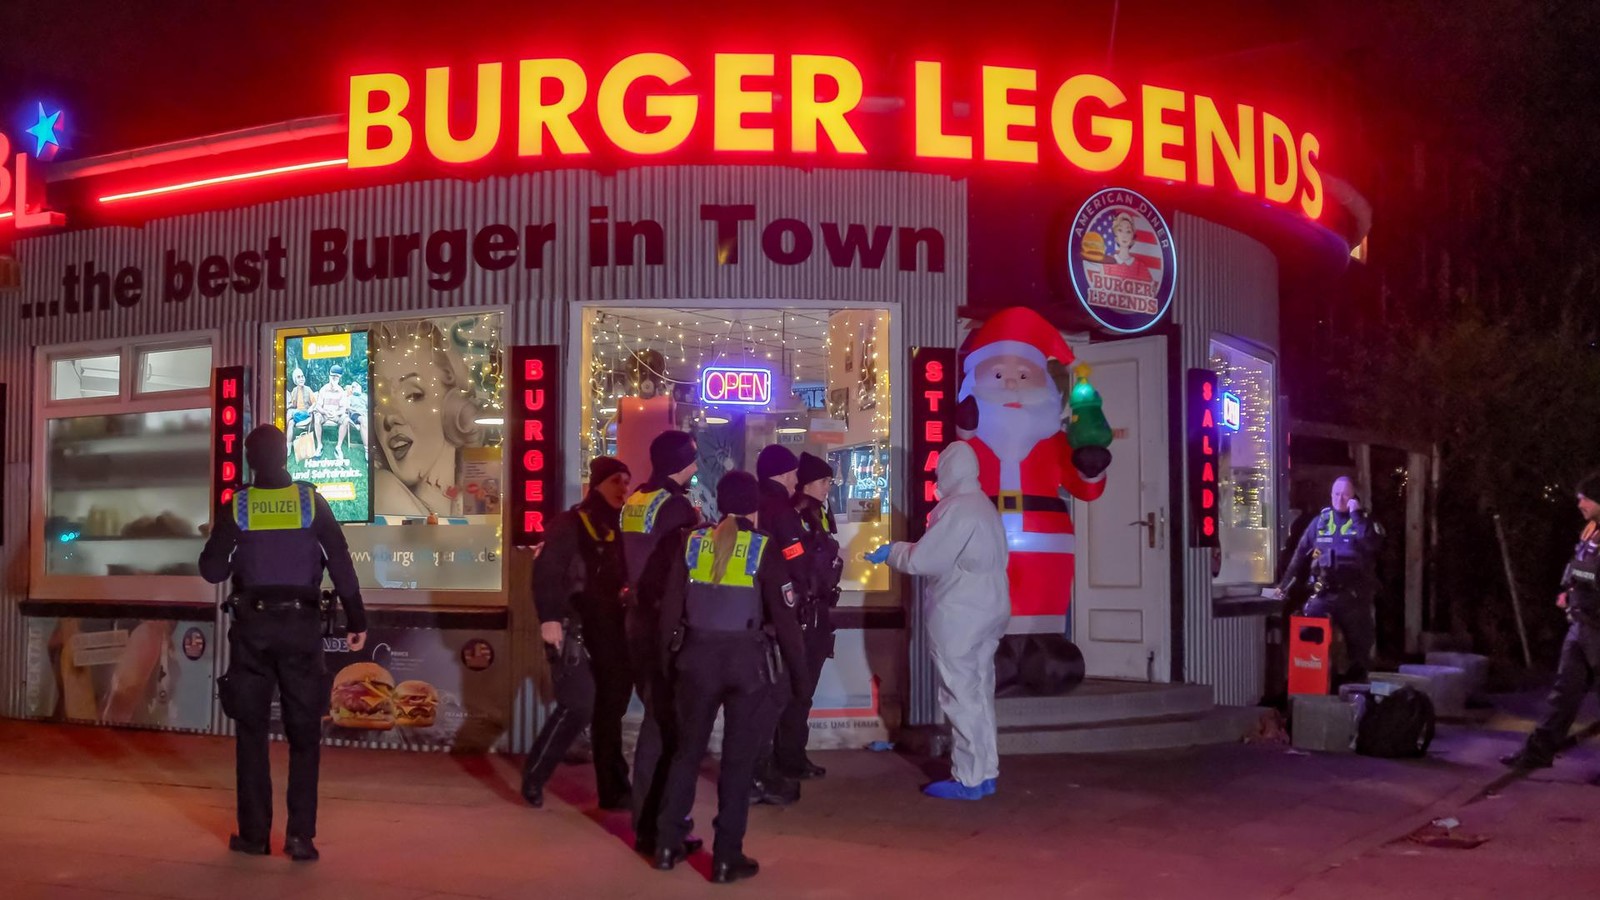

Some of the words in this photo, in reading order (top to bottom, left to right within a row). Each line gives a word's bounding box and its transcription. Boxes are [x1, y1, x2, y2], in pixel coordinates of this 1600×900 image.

[347, 52, 868, 170] BURGER
[914, 59, 1324, 220] LEGENDS
[163, 236, 287, 303] best
[310, 220, 556, 292] Burger
[588, 205, 665, 268] in
[700, 204, 945, 273] Town
[1075, 192, 1134, 238] AMERICAN
[1138, 199, 1169, 249] DINER
[1089, 290, 1157, 314] LEGENDS
[1094, 275, 1155, 296] BURGER
[706, 371, 767, 401] OPEN
[523, 359, 545, 533] BURGER
[924, 360, 943, 528] STEAK
[1202, 381, 1215, 537] SALADS
[252, 500, 297, 515] POLIZEI
